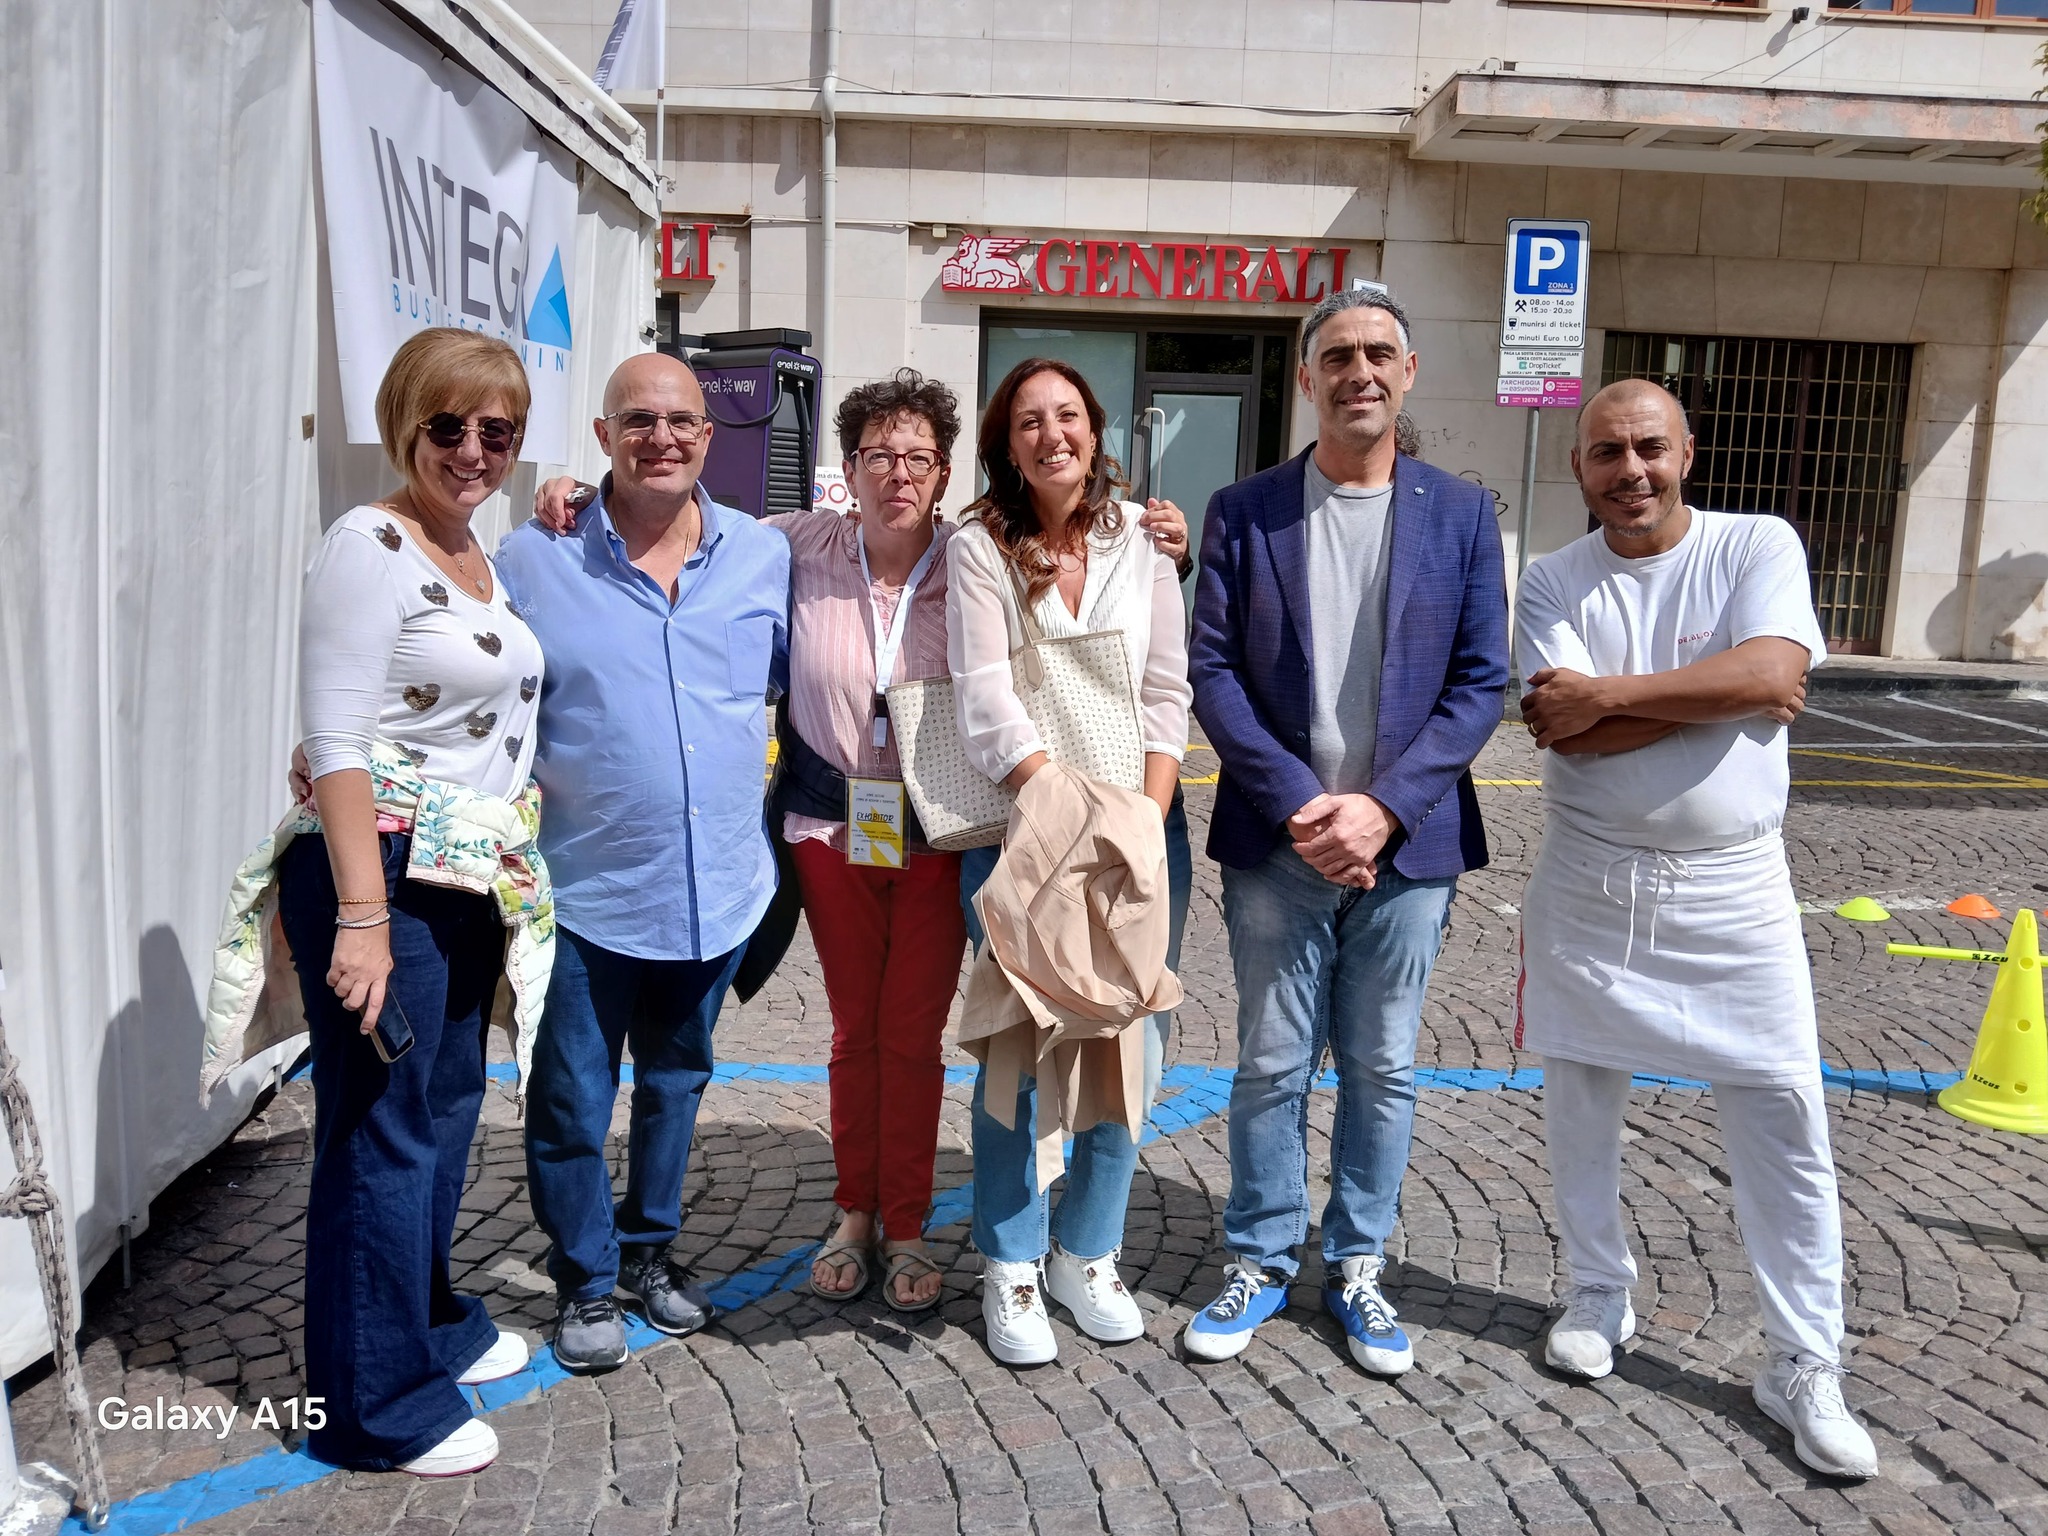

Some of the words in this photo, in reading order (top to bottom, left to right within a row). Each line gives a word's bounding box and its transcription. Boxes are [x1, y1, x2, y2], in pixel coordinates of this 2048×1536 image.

[1036, 238, 1351, 303] GENERALI
[1528, 237, 1566, 287] P
[777, 360, 793, 370] enel
[800, 364, 815, 374] way
[734, 379, 756, 397] way
[1977, 1076, 2001, 1090] Zeus
